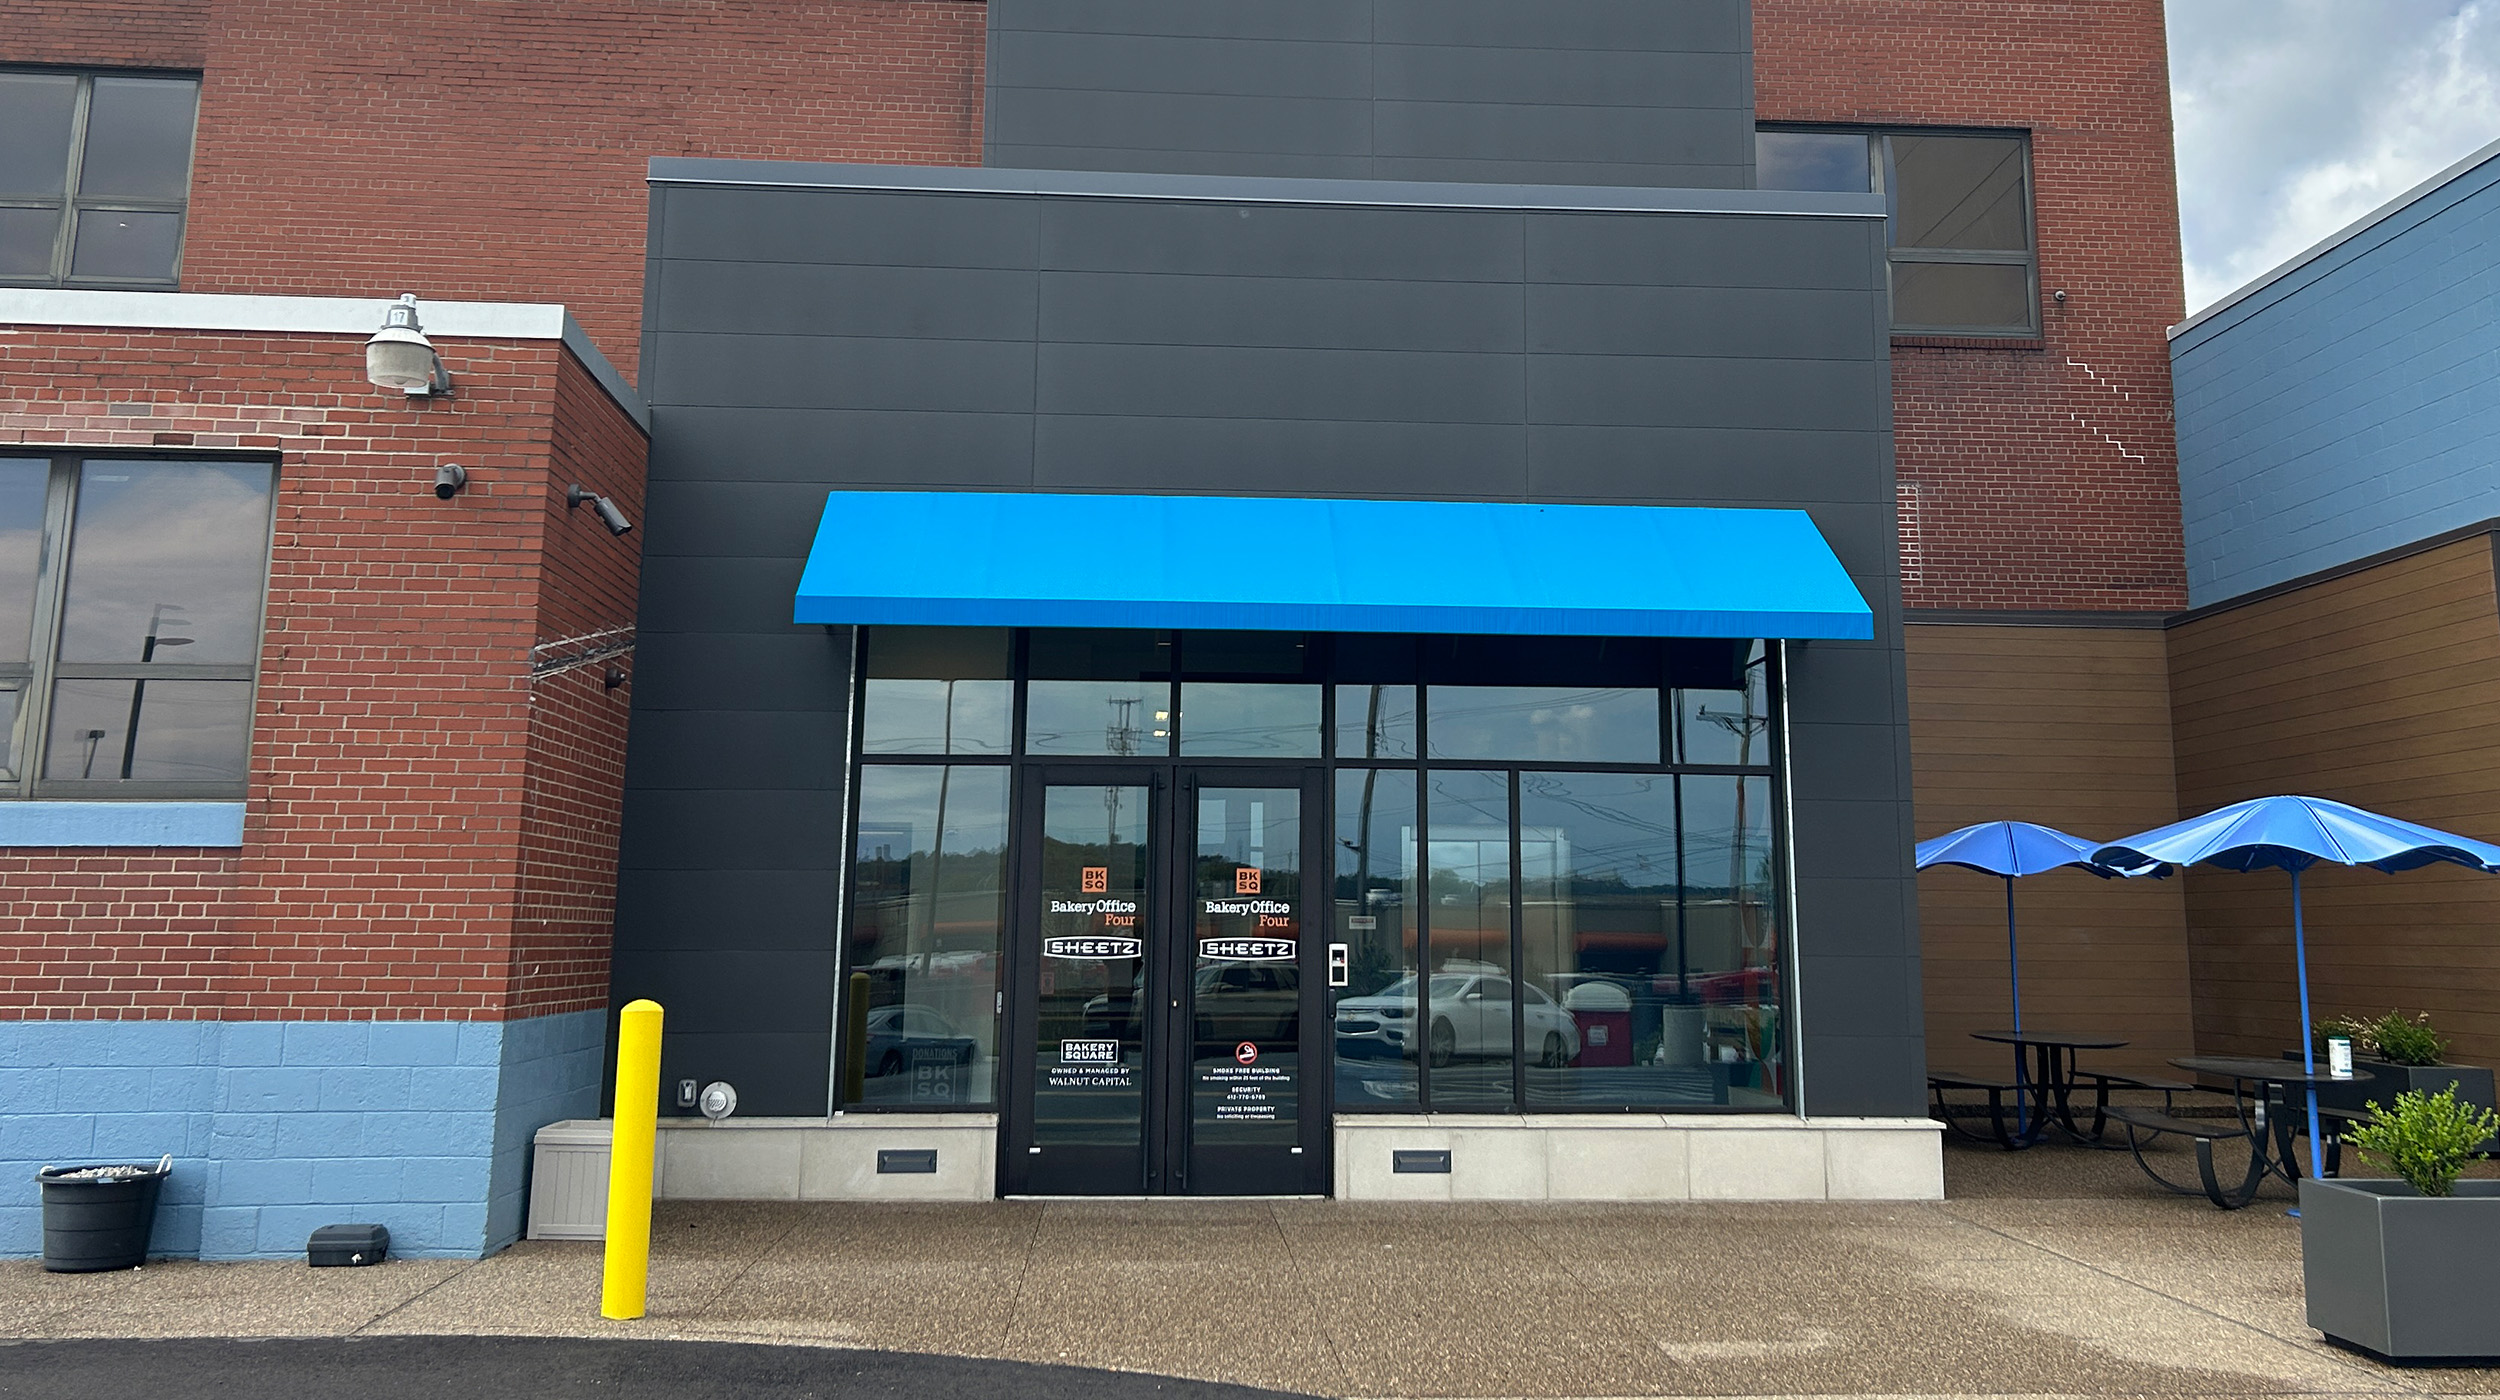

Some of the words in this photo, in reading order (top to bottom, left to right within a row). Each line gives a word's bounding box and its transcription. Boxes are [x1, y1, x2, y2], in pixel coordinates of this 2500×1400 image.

[393, 311, 406, 323] 17
[1085, 870, 1104, 879] BK
[1239, 872, 1258, 880] BK
[1084, 880, 1105, 890] SQ
[1239, 881, 1259, 891] SQ
[1104, 913, 1136, 926] Four
[1259, 914, 1290, 927] Four
[1051, 941, 1135, 954] SHEETZ
[1206, 942, 1289, 955] SHEETZ
[1065, 1043, 1115, 1051] BAKERY
[912, 1048, 958, 1060] DONATIONS
[1064, 1051, 1114, 1060] SQUARE
[917, 1065, 949, 1080] BK
[1049, 1077, 1090, 1086] WALNUT
[1091, 1077, 1132, 1086] CAPITAL
[917, 1082, 950, 1098] SQ
